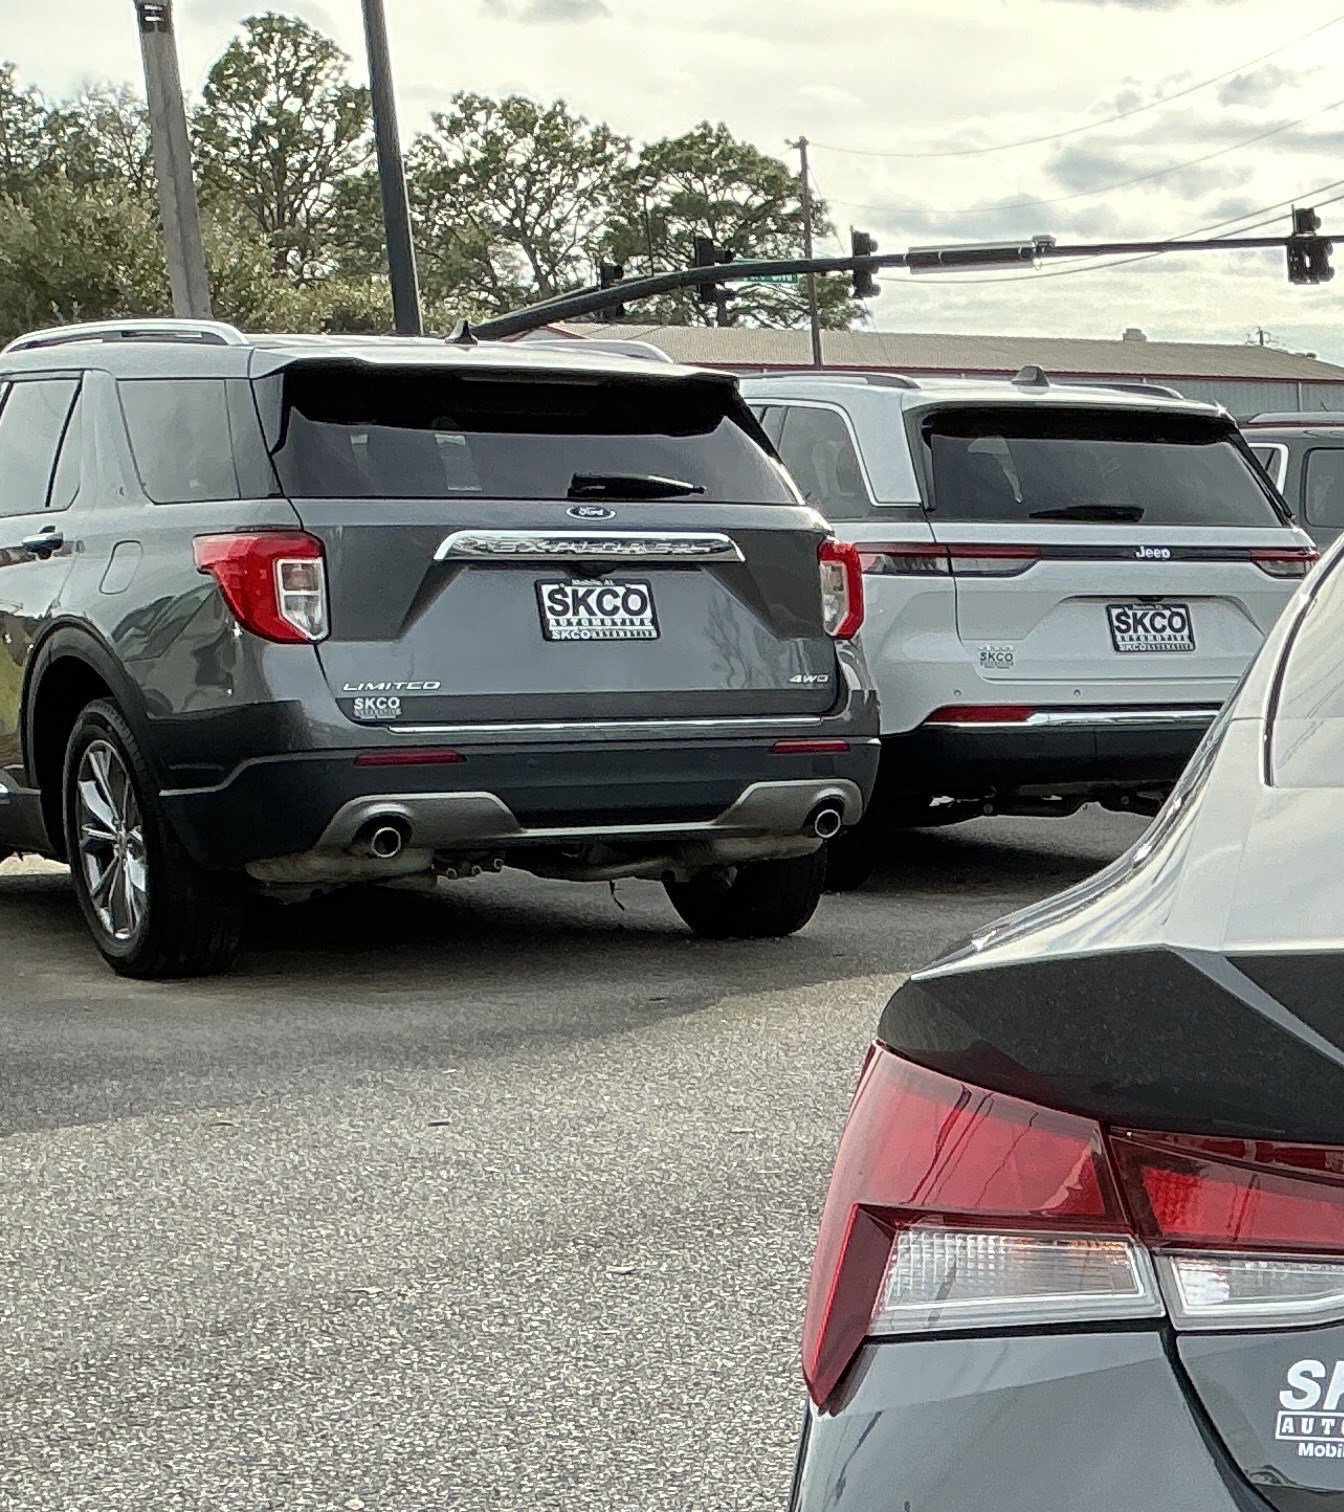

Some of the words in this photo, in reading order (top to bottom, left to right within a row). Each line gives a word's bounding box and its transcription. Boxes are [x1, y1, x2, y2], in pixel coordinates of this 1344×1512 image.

[547, 588, 648, 617] SKCO
[1115, 612, 1186, 634] SKCO
[980, 652, 1014, 662] SKCO
[789, 674, 829, 683] 4WD
[343, 681, 441, 691] LIMITED
[353, 697, 401, 710] SKCO
